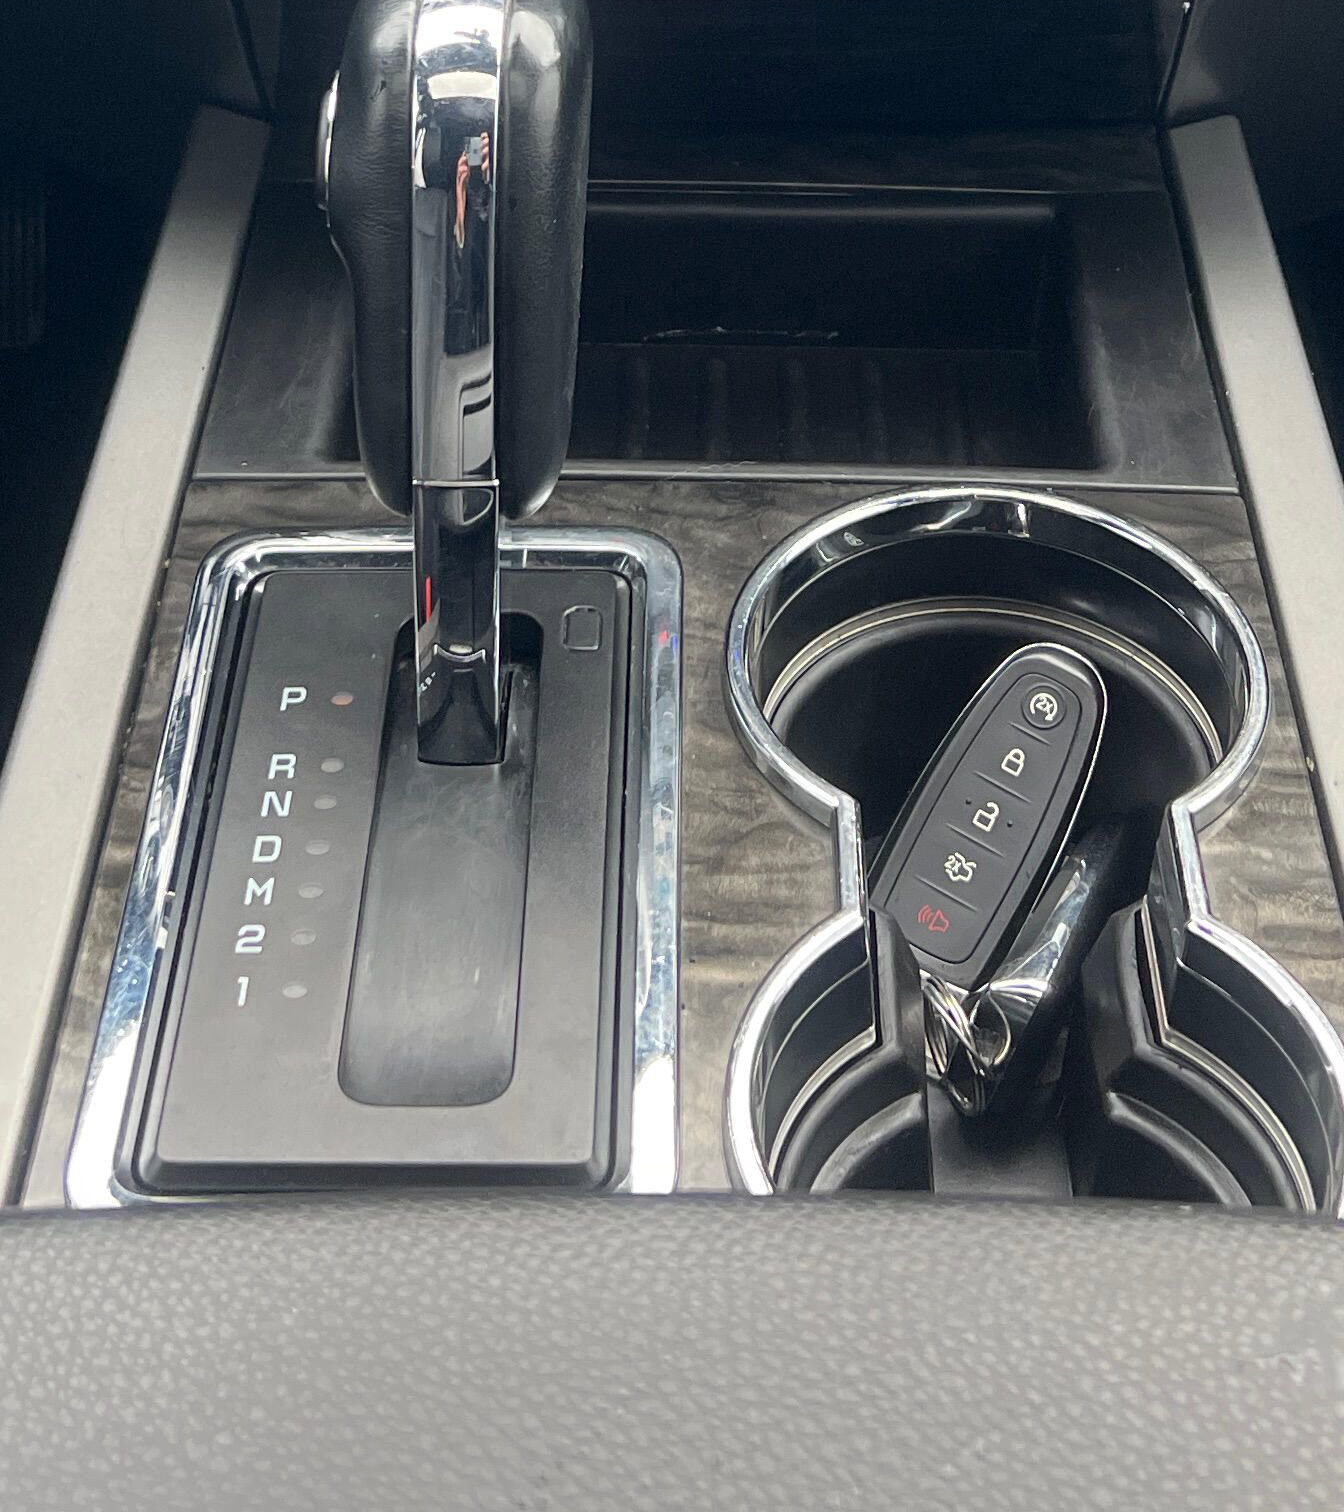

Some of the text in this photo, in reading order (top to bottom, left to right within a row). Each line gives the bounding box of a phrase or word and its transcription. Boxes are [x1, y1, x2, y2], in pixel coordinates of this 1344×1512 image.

[280, 687, 306, 711] P
[268, 754, 296, 779] R
[261, 791, 292, 817] N
[252, 836, 281, 862] D
[244, 878, 274, 905] M
[235, 925, 265, 953] 2
[238, 977, 248, 1006] 1
